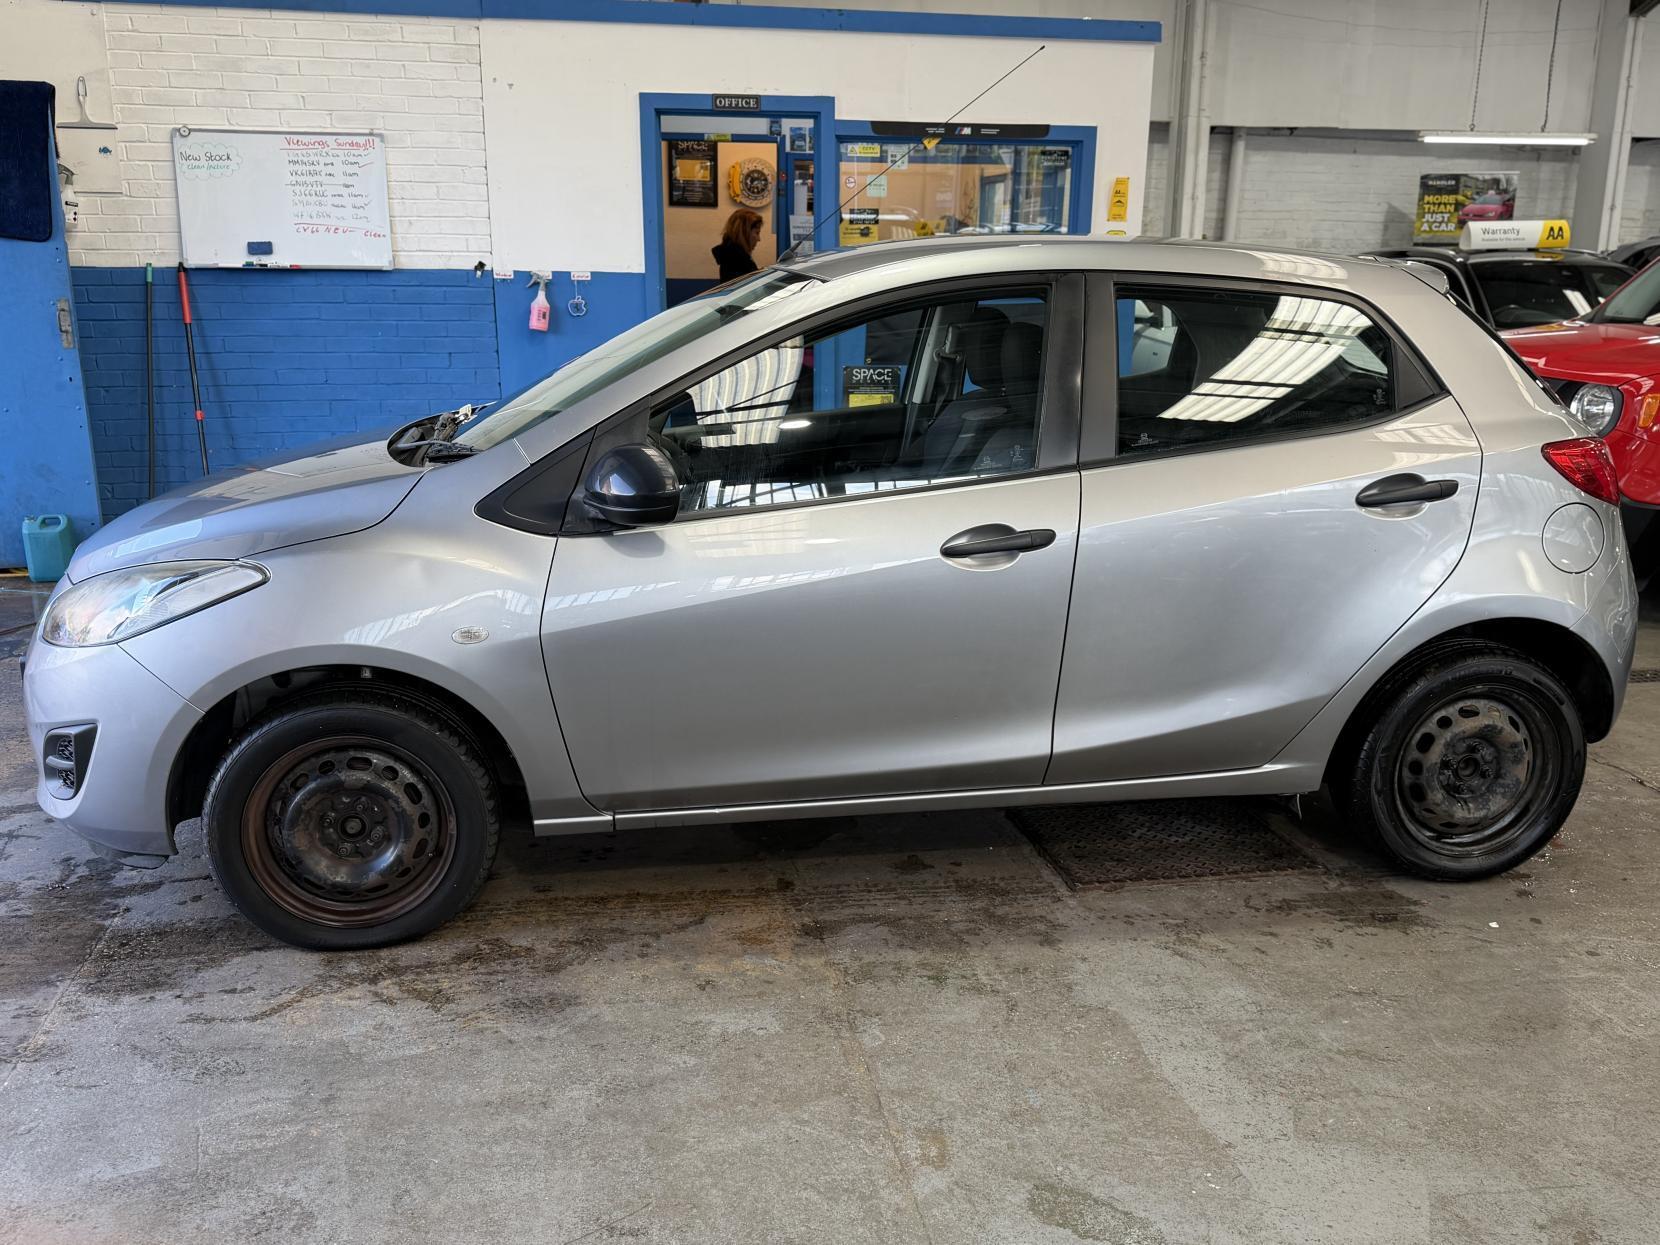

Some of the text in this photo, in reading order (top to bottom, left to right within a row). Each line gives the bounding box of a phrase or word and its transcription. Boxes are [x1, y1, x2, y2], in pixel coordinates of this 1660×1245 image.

[716, 98, 757, 108] OFFICE
[285, 137, 330, 149] Viewings
[180, 150, 232, 161] New Stock
[1423, 194, 1457, 204] MORE
[1423, 204, 1455, 213] THAN
[1422, 213, 1450, 222] JUST
[1420, 222, 1457, 231] A CAR
[1481, 226, 1564, 240] Warranty AA
[852, 368, 892, 380] SPACE
